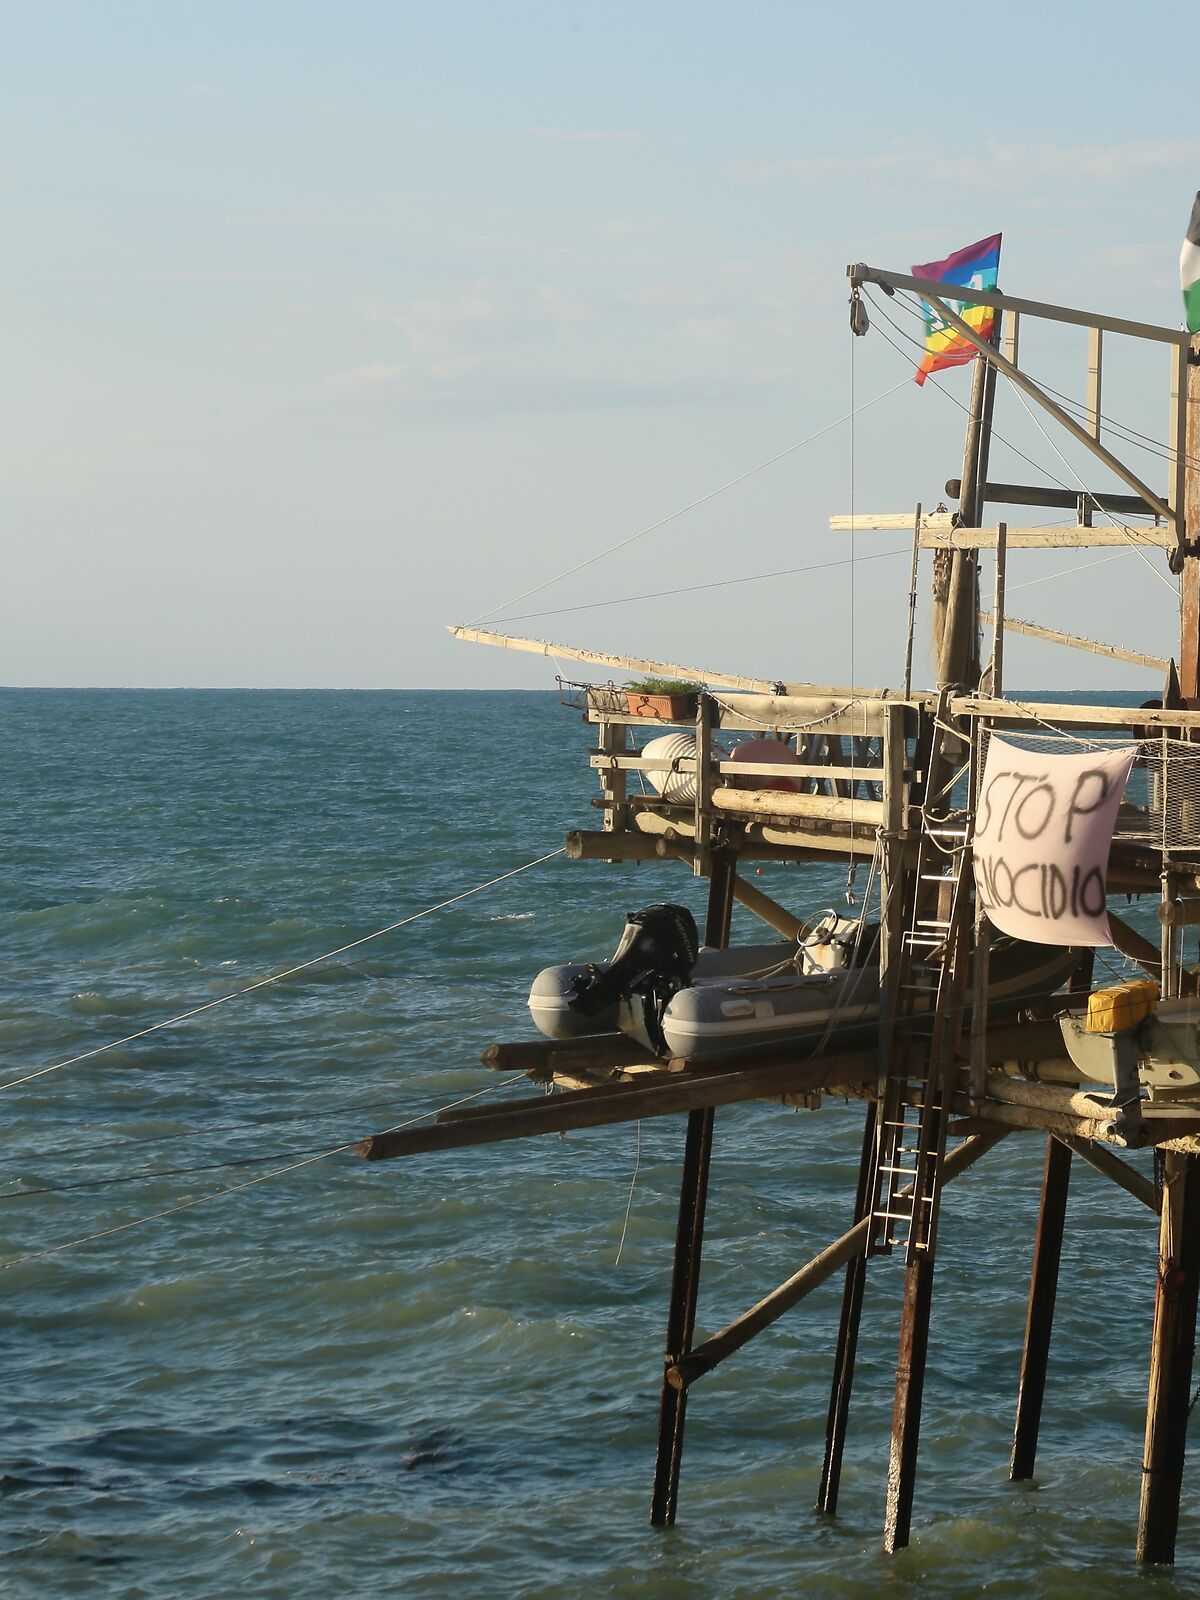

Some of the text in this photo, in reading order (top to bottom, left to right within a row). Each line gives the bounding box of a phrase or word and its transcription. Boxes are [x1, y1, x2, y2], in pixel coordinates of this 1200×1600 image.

[974, 769, 1109, 844] STOP
[972, 853, 1108, 920] ENOCIDIO
[674, 919, 695, 963] MERCURY
